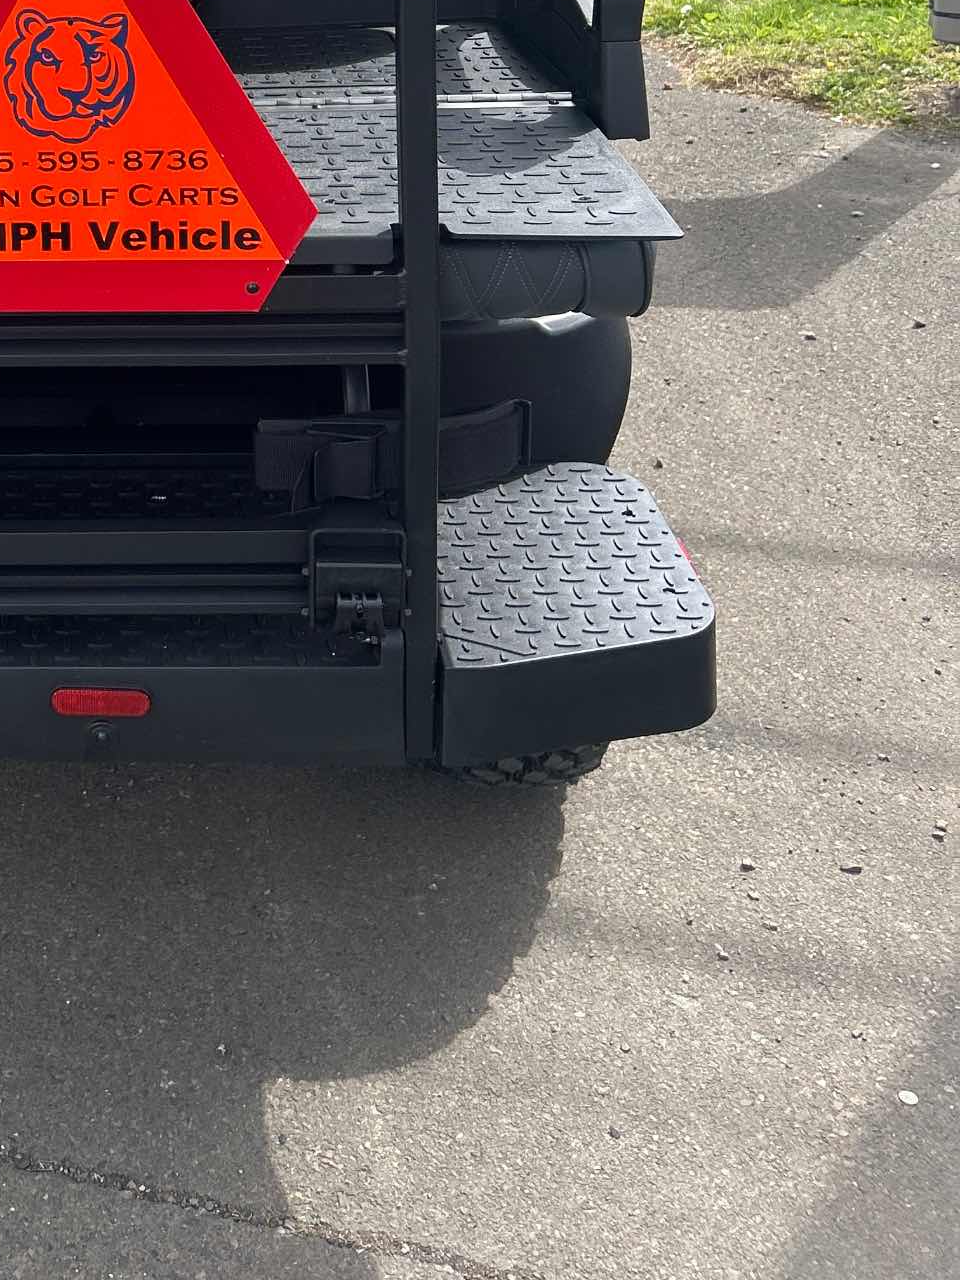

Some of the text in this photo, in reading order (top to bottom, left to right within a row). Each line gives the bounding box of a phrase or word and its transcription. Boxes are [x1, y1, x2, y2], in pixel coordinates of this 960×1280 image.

[30, 185, 119, 207] GOLF
[128, 184, 239, 206] CARTS
[88, 220, 262, 251] Vehicle
